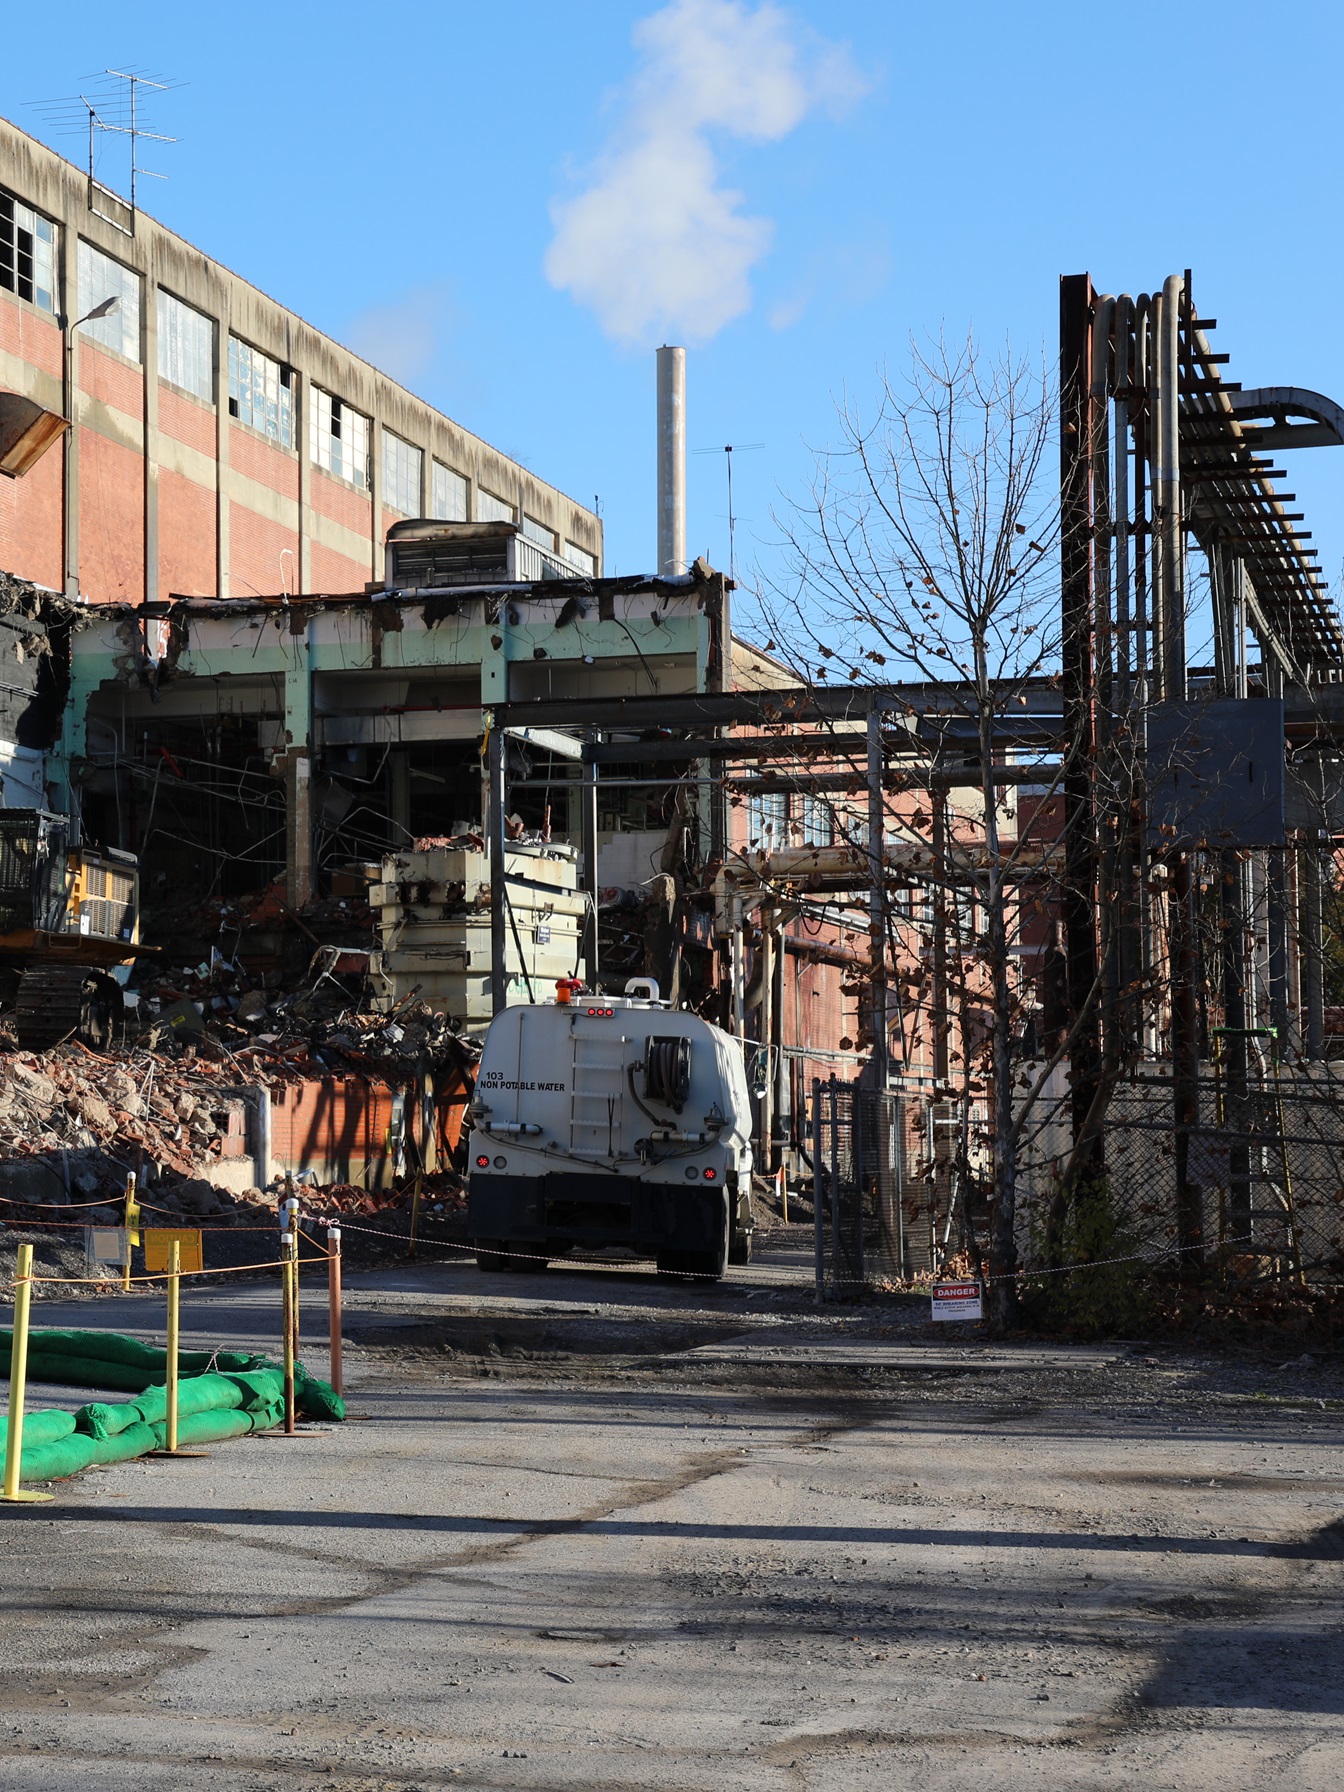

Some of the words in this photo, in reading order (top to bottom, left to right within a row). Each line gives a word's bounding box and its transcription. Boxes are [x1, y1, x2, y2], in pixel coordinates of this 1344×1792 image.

[486, 1072, 504, 1080] 103
[480, 1081, 498, 1089] NON
[501, 1081, 535, 1090] POTABLE
[537, 1083, 565, 1091] WATER
[938, 1288, 975, 1297] DANGER
